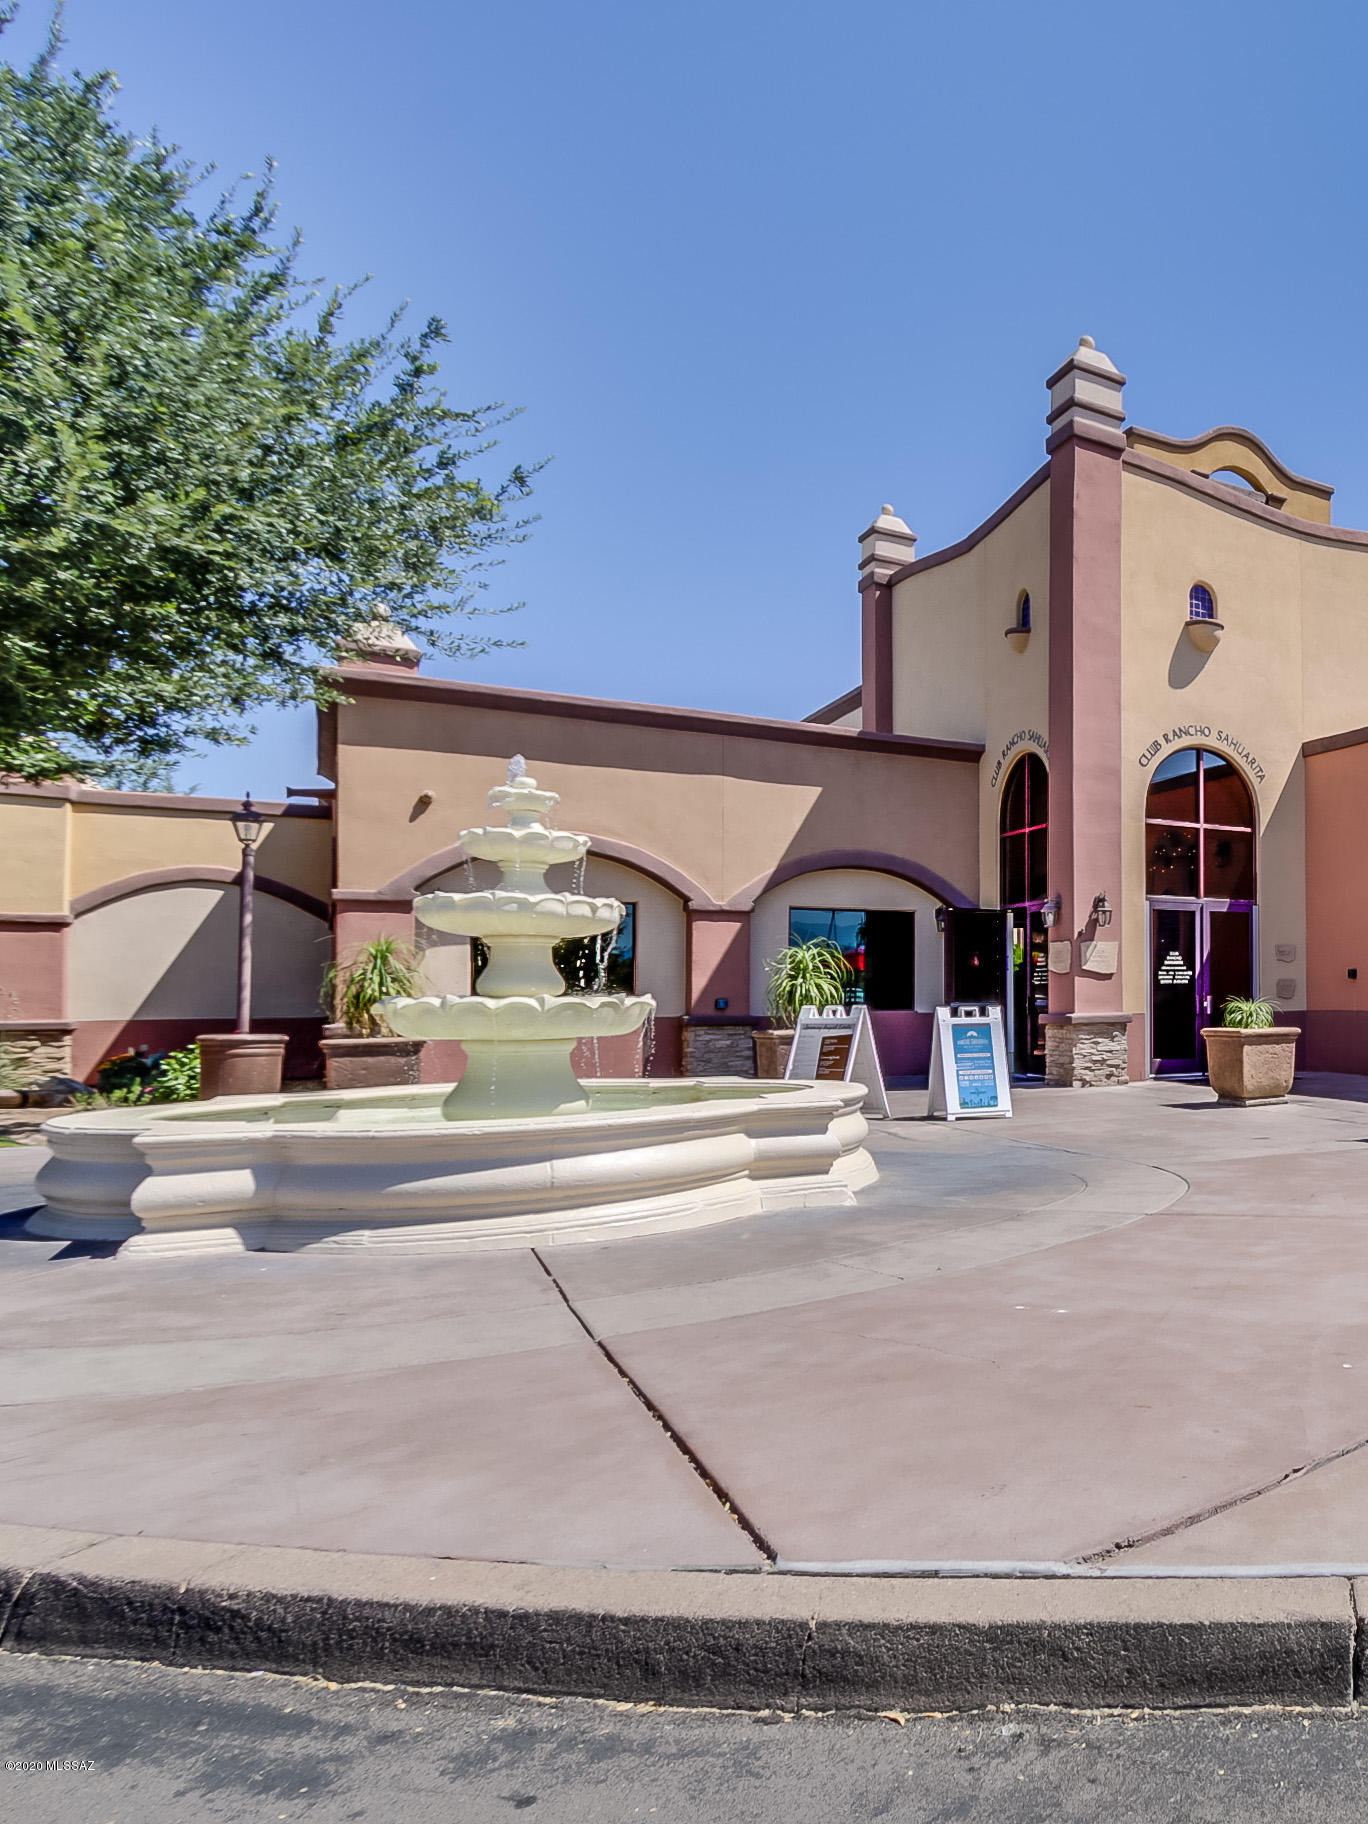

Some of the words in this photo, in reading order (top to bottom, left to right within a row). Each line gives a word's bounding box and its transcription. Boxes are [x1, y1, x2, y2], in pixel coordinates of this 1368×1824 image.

[991, 759, 1002, 788] CLUB
[1002, 730, 1026, 761] RANCHO
[1138, 740, 1162, 768] CLUB
[1162, 725, 1211, 745] RANCHO
[1216, 730, 1266, 785] SAHUARITA
